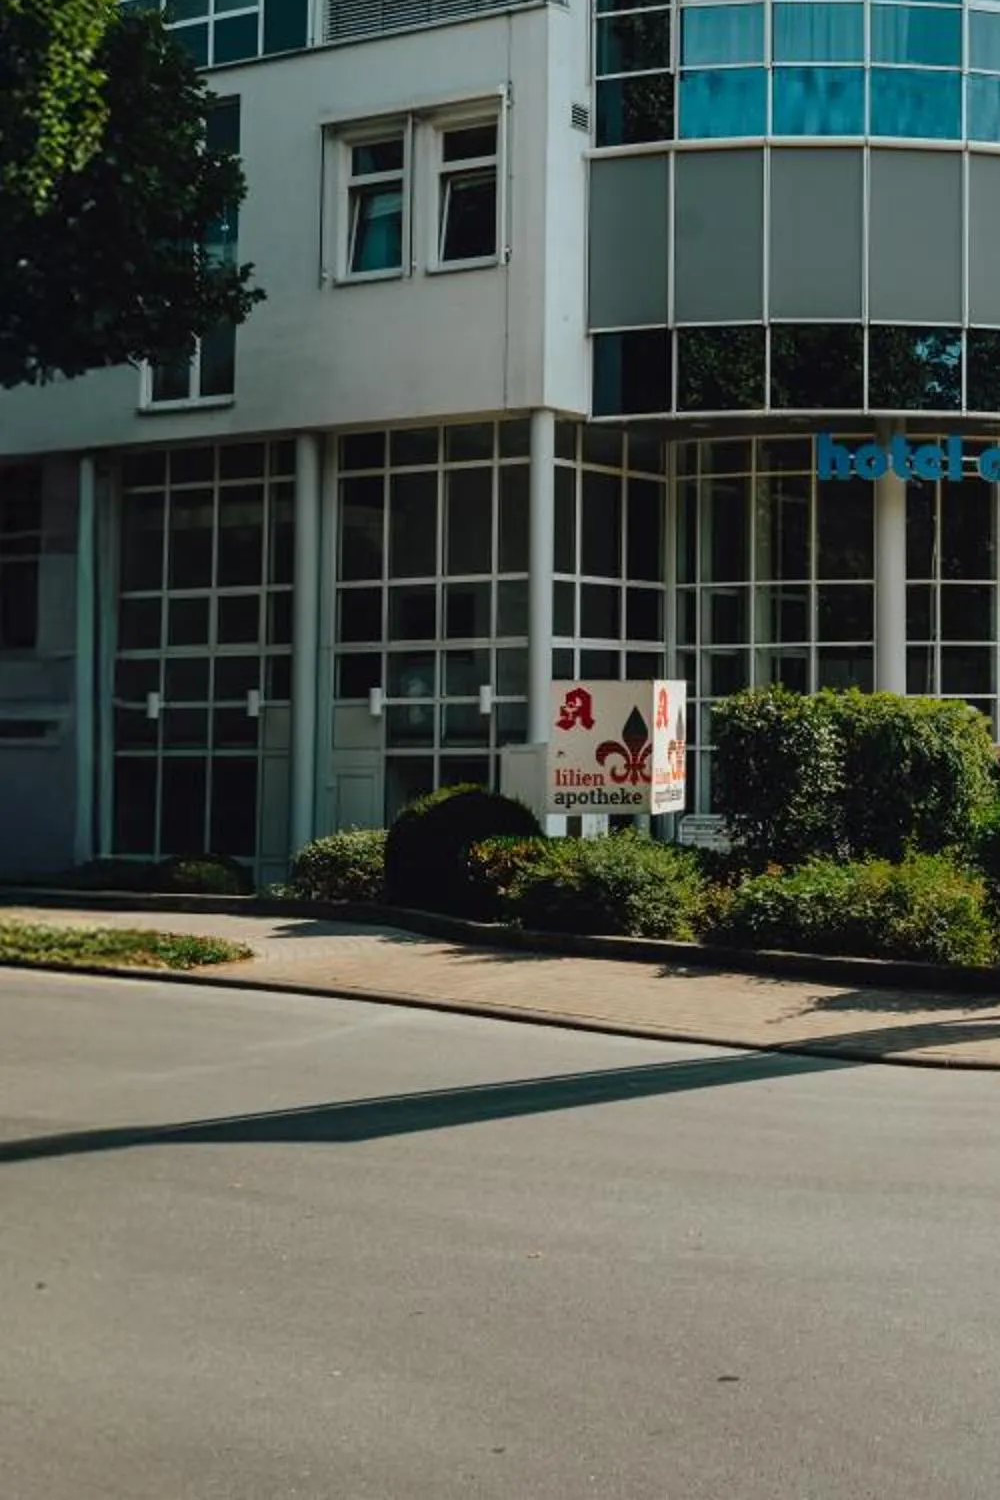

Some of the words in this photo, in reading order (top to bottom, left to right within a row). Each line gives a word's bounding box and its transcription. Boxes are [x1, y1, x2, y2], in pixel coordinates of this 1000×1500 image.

[816, 431, 962, 481] hotel
[555, 687, 596, 730] A
[555, 769, 606, 787] lilien
[554, 788, 644, 809] apotheke
